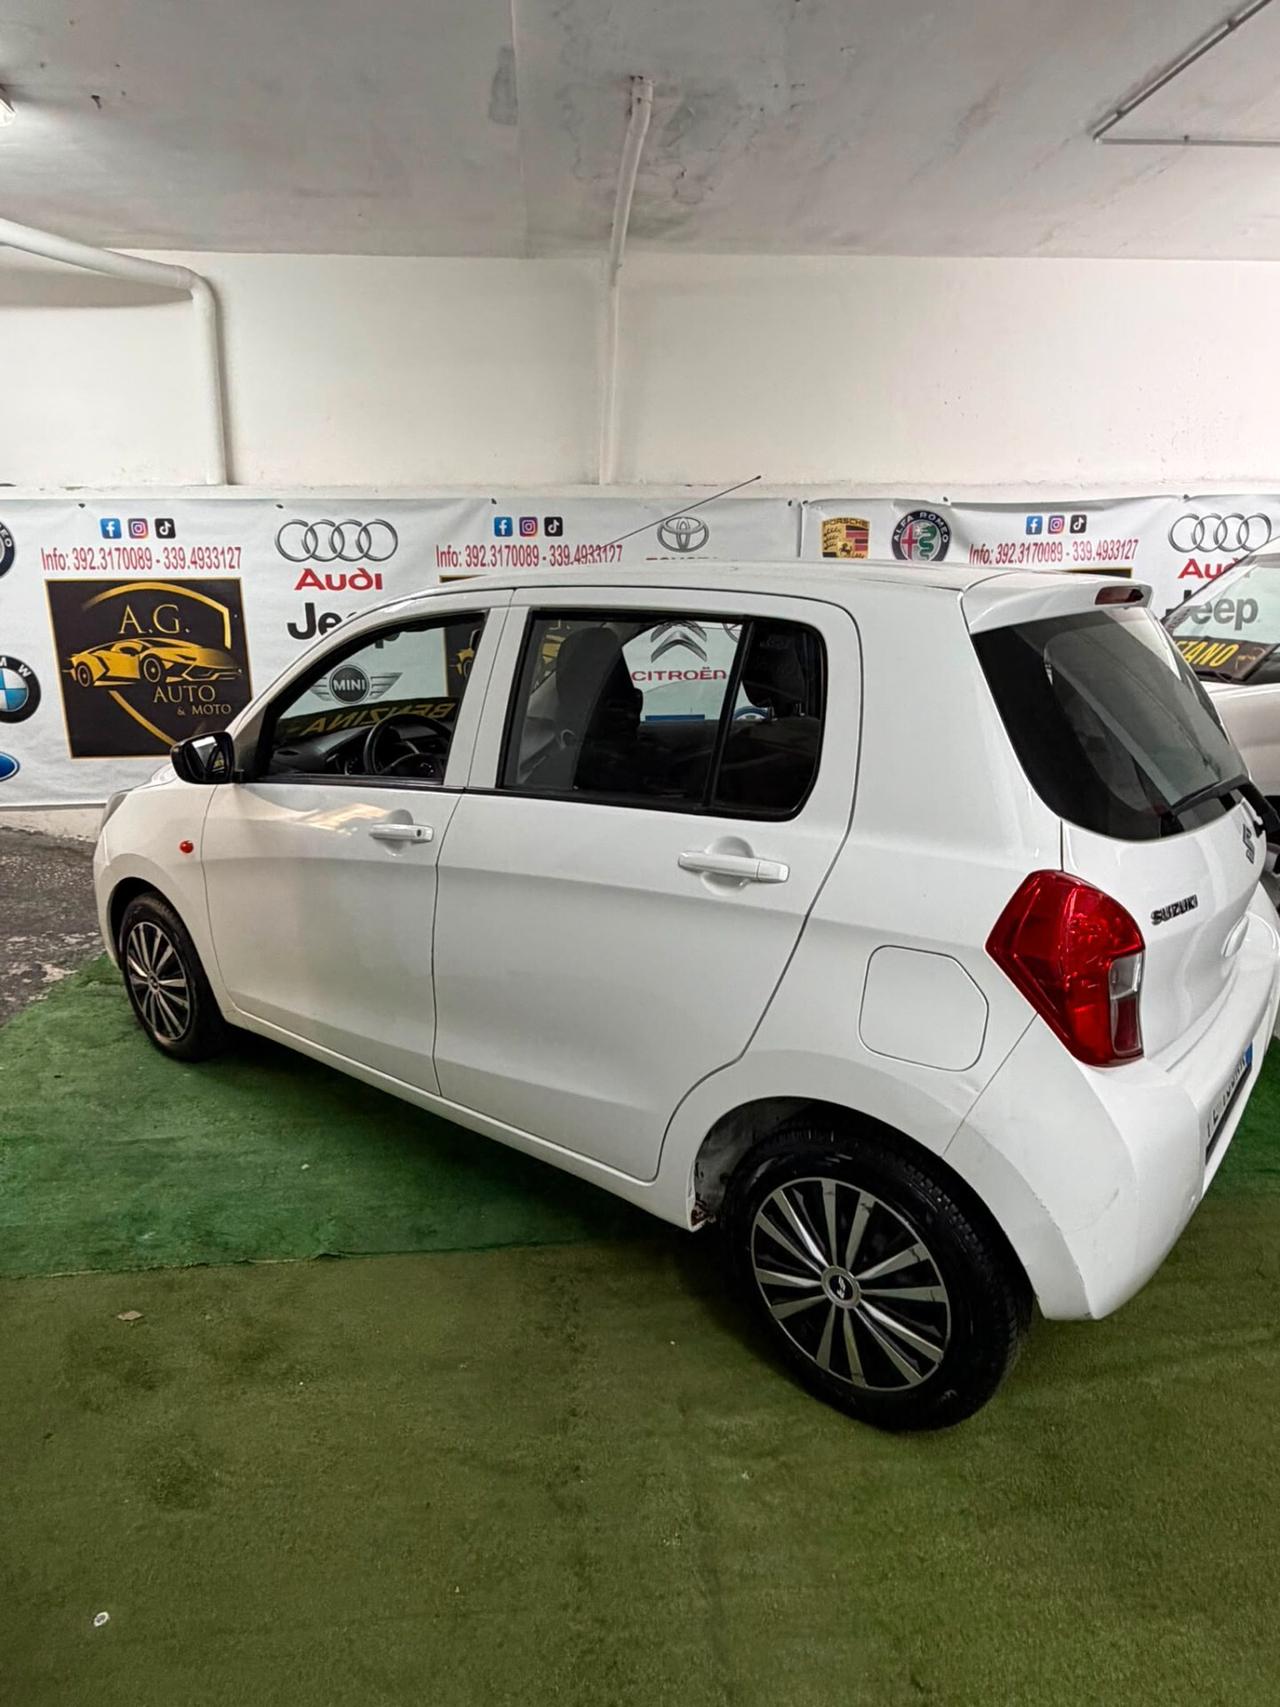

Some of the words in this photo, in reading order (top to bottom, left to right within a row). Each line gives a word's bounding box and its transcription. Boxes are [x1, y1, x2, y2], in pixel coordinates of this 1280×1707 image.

[893, 515, 914, 542] ALFA
[919, 511, 949, 543] ROMEO
[41, 547, 70, 571] Info:
[72, 547, 152, 571] 392.3170089
[163, 546, 242, 570] 339.4933127
[436, 544, 462, 567] Info:
[465, 544, 539, 568] 392.3170089
[549, 544, 623, 566] 339.4933127
[969, 543, 993, 565] Info:
[995, 541, 1063, 564] 392.3170089
[1072, 539, 1139, 561] 339.4933127
[294, 568, 384, 591] Audi
[118, 604, 190, 634] A.G.
[153, 685, 216, 703] AUTO
[333, 679, 367, 691] MINI
[177, 705, 186, 716] &
[192, 703, 232, 715] MOTO
[1151, 894, 1198, 926] SUZUKI
